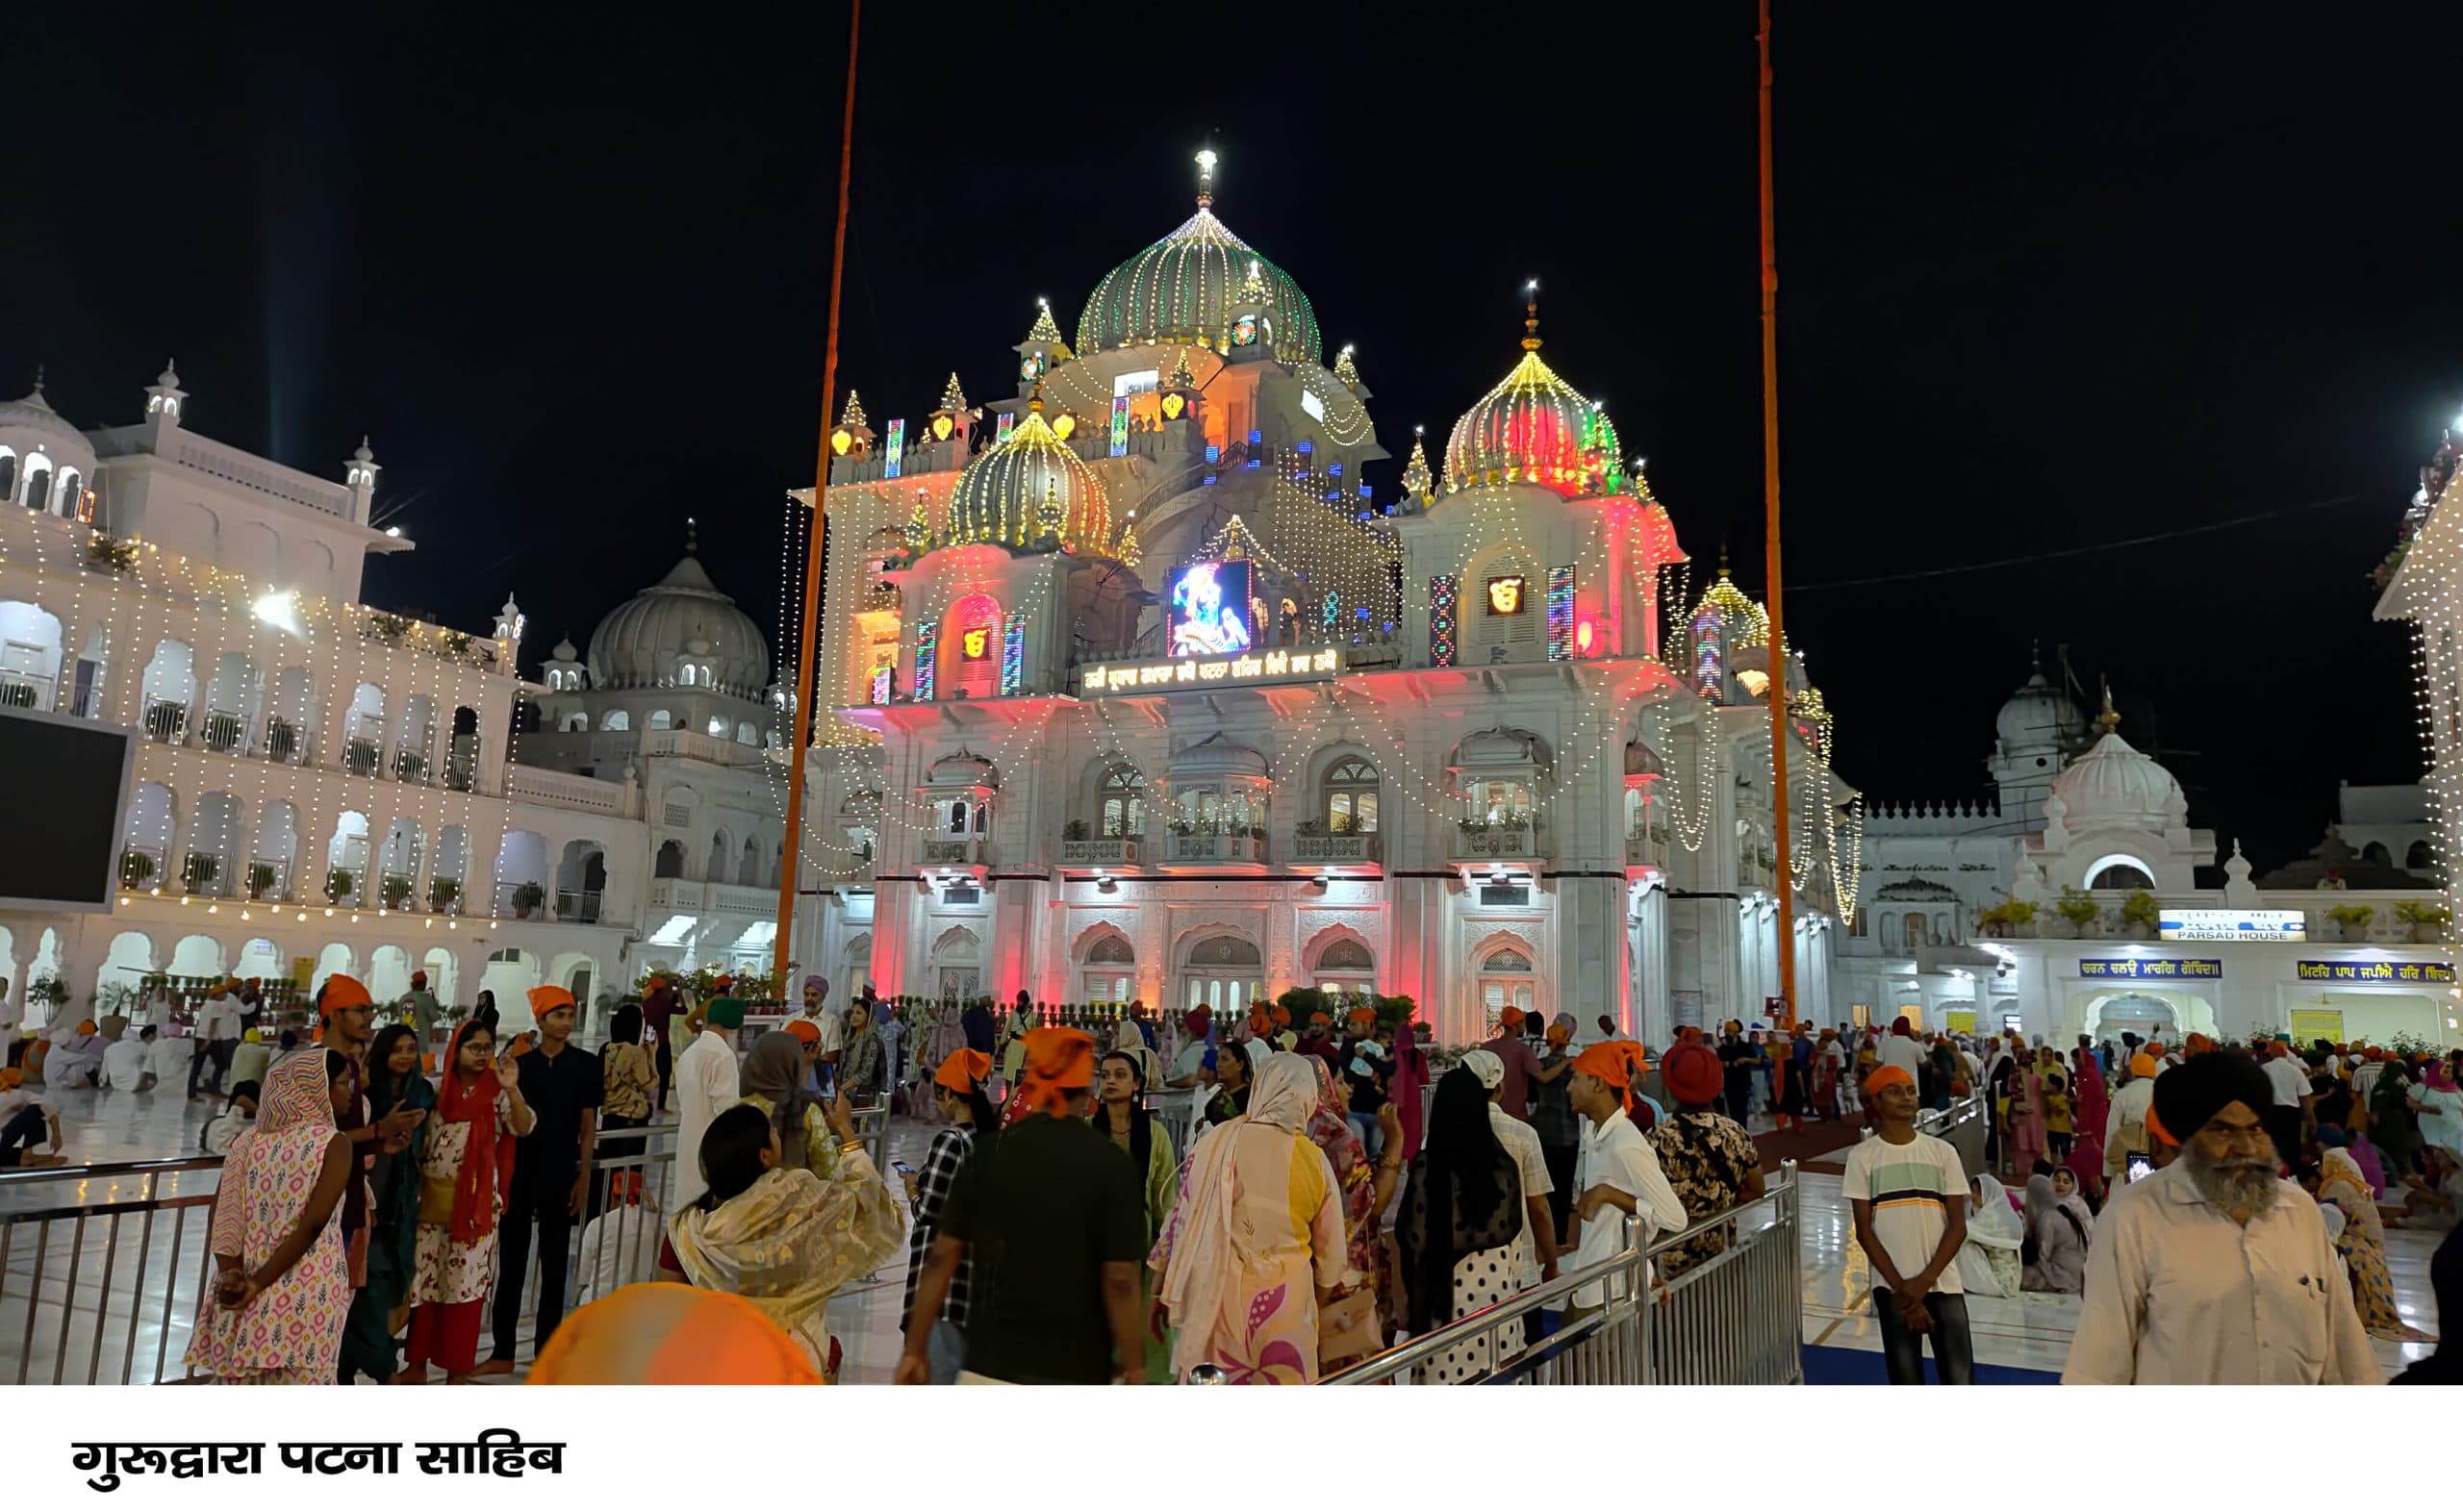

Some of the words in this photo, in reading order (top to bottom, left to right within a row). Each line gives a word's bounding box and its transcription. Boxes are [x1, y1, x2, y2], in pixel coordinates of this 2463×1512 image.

[1199, 662, 1229, 679] ਪਟਨਾ
[2177, 931, 2234, 940] PARSAD
[2239, 931, 2287, 941] HOUSE
[2082, 963, 2106, 973] ਚਰਨ
[2336, 967, 2355, 978] ਪਾਪ
[2400, 965, 2420, 979] ਹਰਿ
